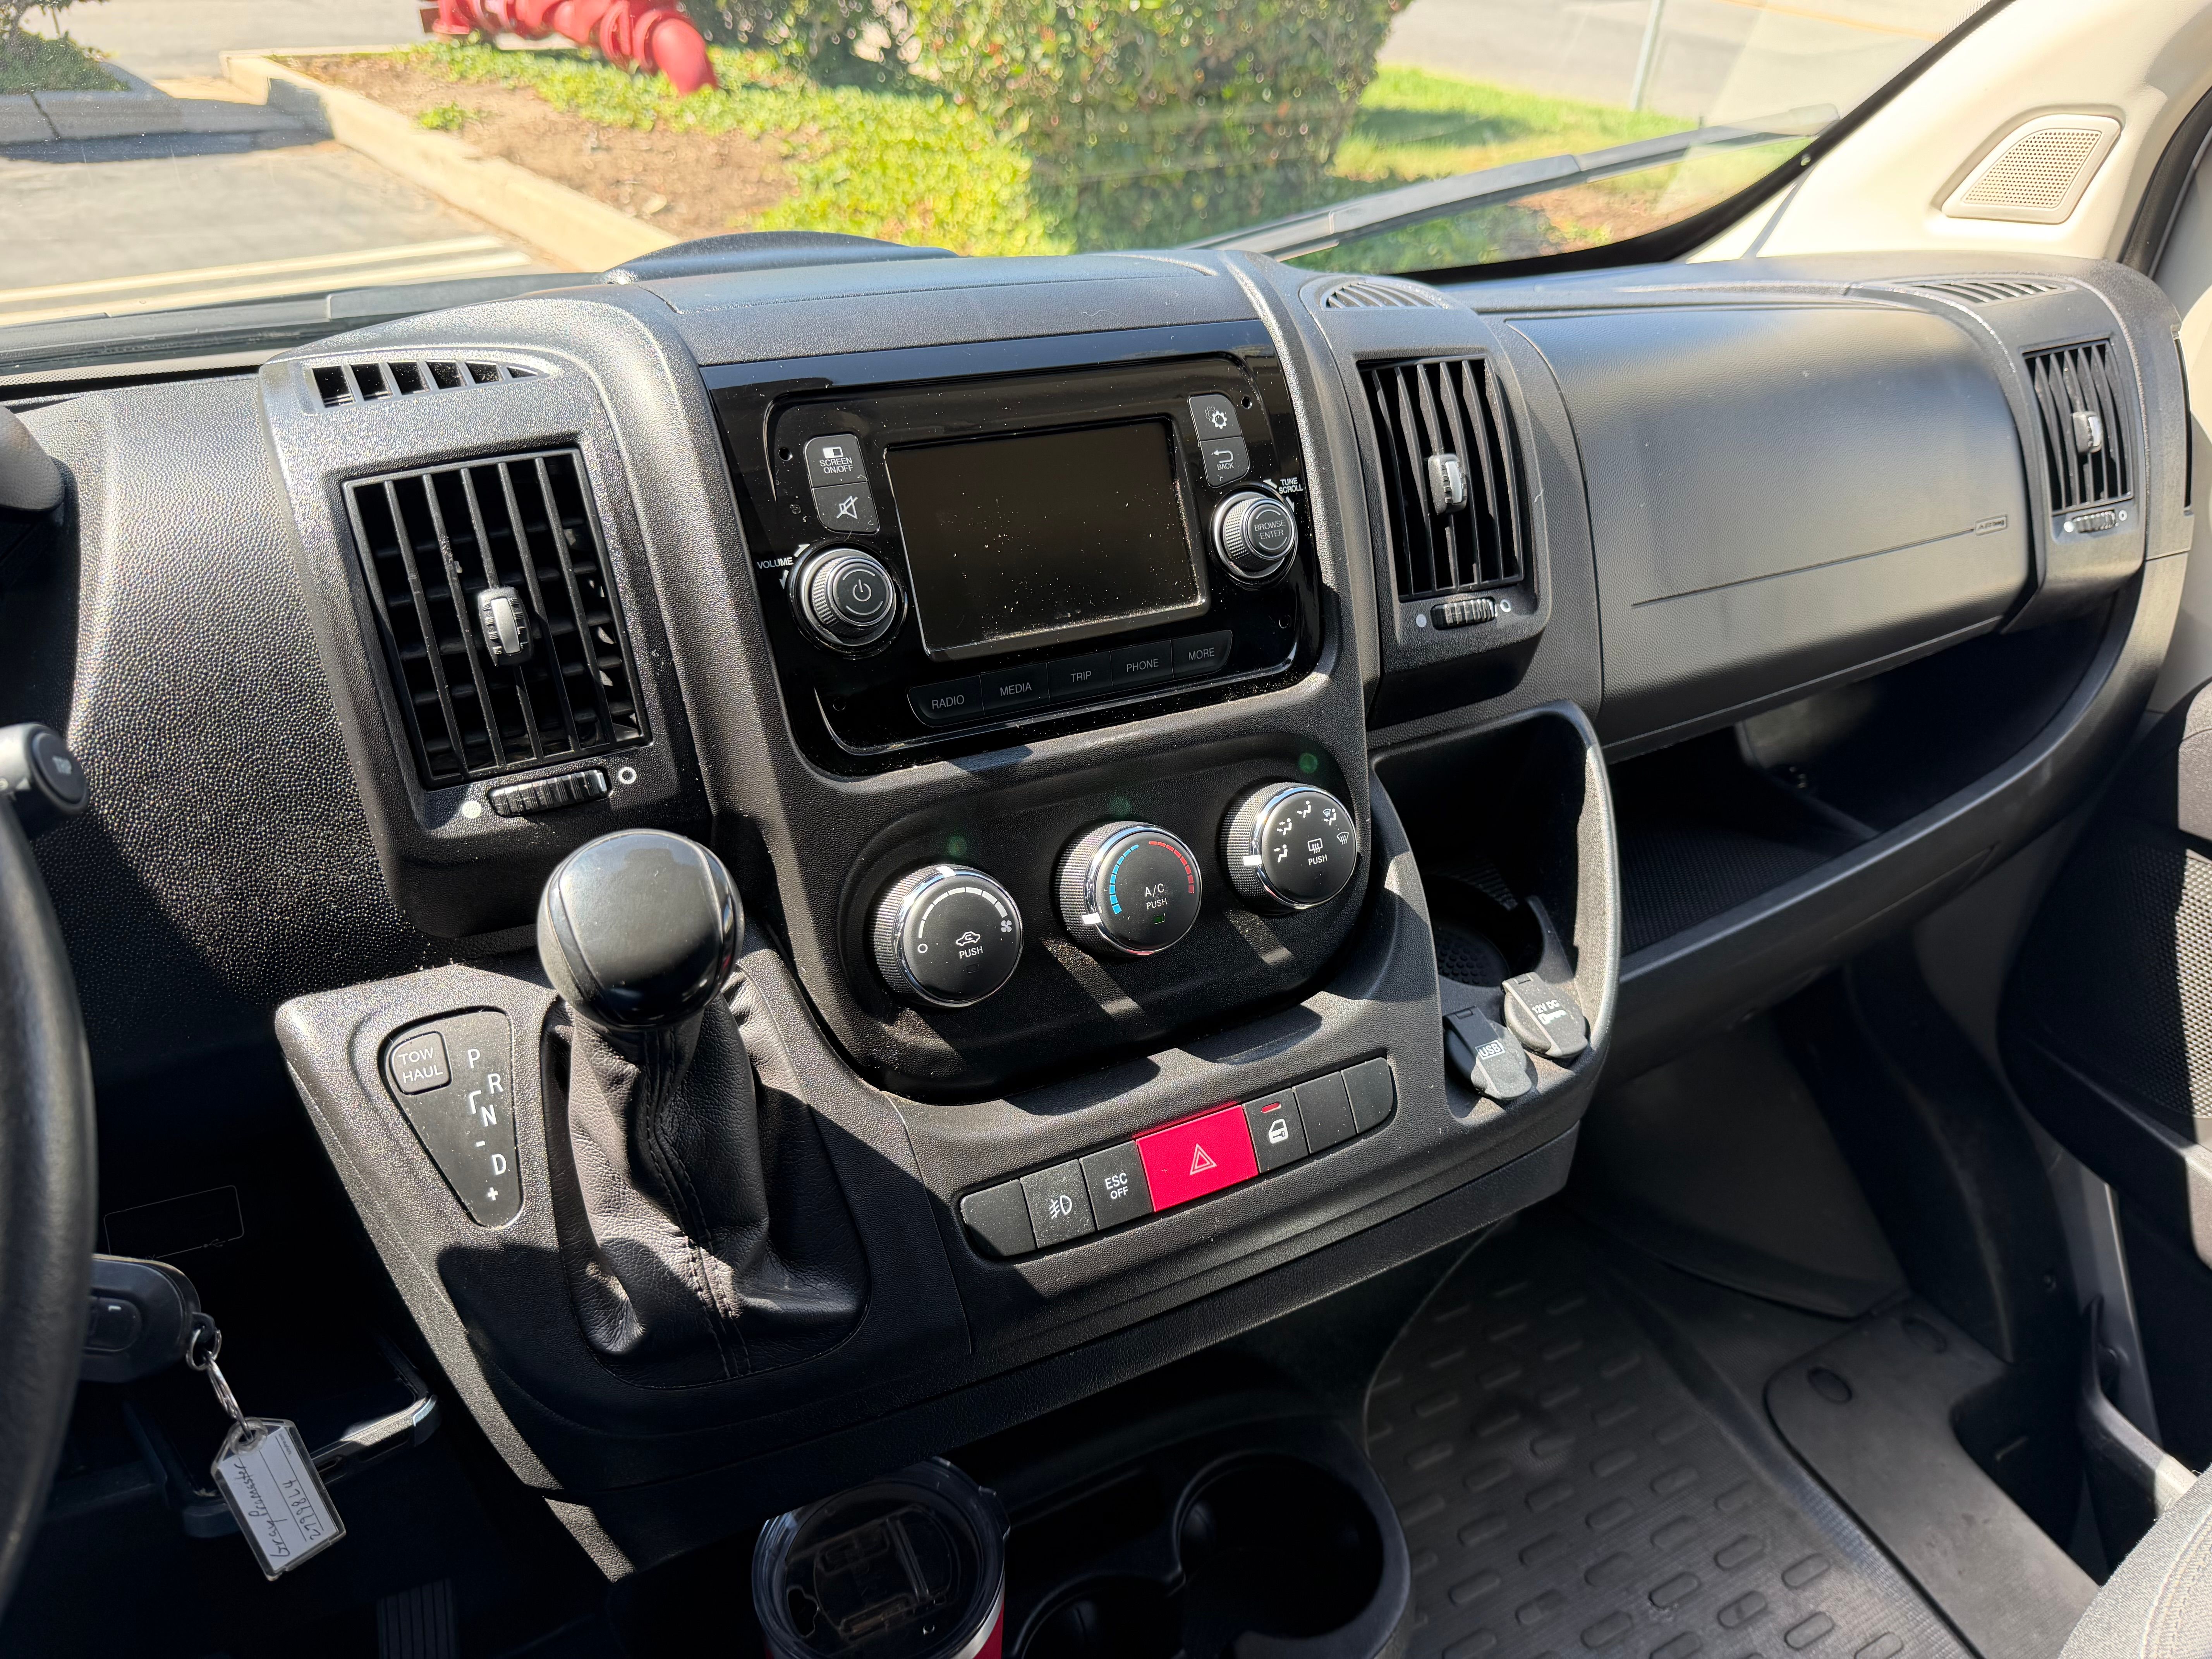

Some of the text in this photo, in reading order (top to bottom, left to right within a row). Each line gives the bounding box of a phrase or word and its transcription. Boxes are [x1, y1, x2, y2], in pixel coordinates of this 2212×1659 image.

[819, 458, 853, 467] SCREEN
[823, 465, 853, 474] ON/OFF
[1217, 462, 1234, 471] BACK
[1280, 477, 1298, 486] TUNE
[1279, 484, 1304, 495] SCROLL
[1254, 519, 1286, 532] BROWSE
[1260, 529, 1284, 540] ENTER
[757, 557, 794, 569] VOLUME
[1188, 647, 1215, 661] MORE
[1127, 658, 1159, 672] PHONE
[1070, 671, 1091, 682] TRIP
[1000, 682, 1032, 696] MEDIA
[932, 695, 964, 710] RADIO
[1308, 854, 1328, 866] PUSH
[1145, 883, 1164, 897] A/C
[1146, 898, 1168, 910] PUSH
[959, 946, 984, 959] PUSH
[1532, 999, 1560, 1014] 12V DC
[398, 1047, 434, 1065] TOW
[1479, 1043, 1502, 1057] USB
[468, 1048, 481, 1069] P
[402, 1065, 444, 1084] HAUL
[488, 1072, 504, 1094] R
[481, 1104, 497, 1127] N
[492, 1154, 507, 1175] D
[1105, 1172, 1128, 1190] ESC
[1110, 1186, 1128, 1200] OFF
[266, 1518, 290, 1557] Gray
